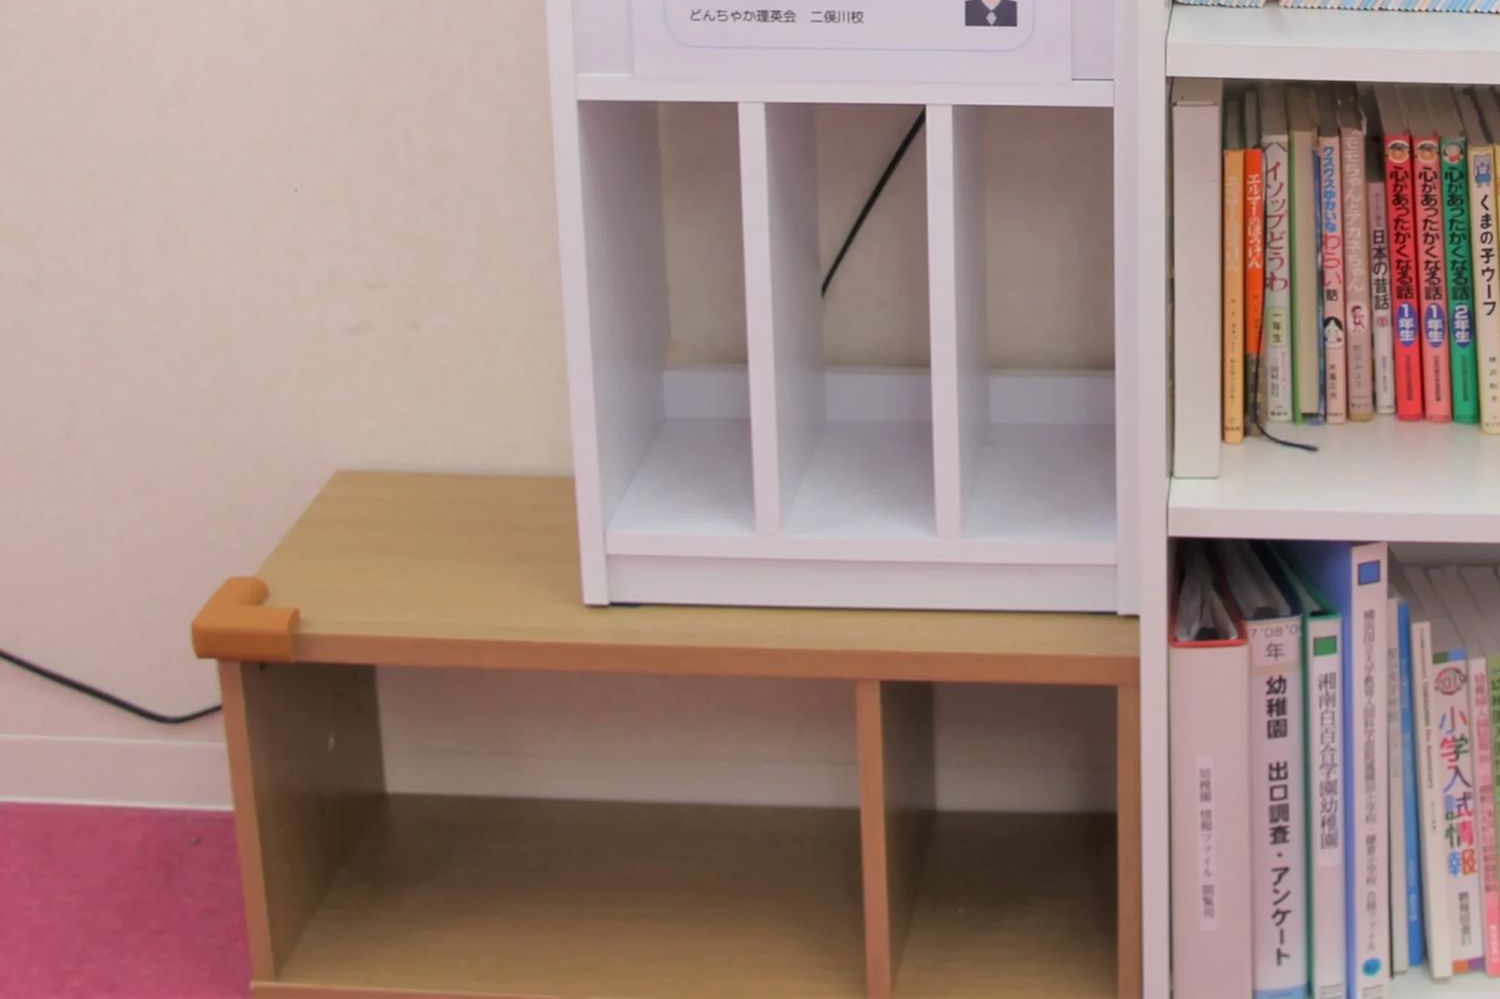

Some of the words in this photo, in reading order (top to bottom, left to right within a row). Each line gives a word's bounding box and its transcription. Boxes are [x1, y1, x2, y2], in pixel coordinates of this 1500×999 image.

[690, 8, 797, 24] どんちゃか理英会
[1263, 161, 1289, 293] イソップどうわ
[1371, 228, 1391, 312] 日本の昔話
[1388, 164, 1416, 301] 心があったかくなる話
[1417, 164, 1444, 301] 心があったかくなる話
[1444, 164, 1470, 301] 心があったかくなる話
[1478, 194, 1498, 318] くまの子ウーフ
[1398, 303, 1416, 345] 1年生
[1425, 303, 1446, 345] 1年生
[1454, 304, 1473, 345] 2年生
[1264, 642, 1285, 661] 年
[1265, 674, 1288, 740] 幼稚園
[1316, 671, 1340, 850] 湘南白百合学園幼稚園
[1438, 704, 1478, 877] 小学入試情報
[1267, 761, 1292, 967] 出口調査・アンケート
